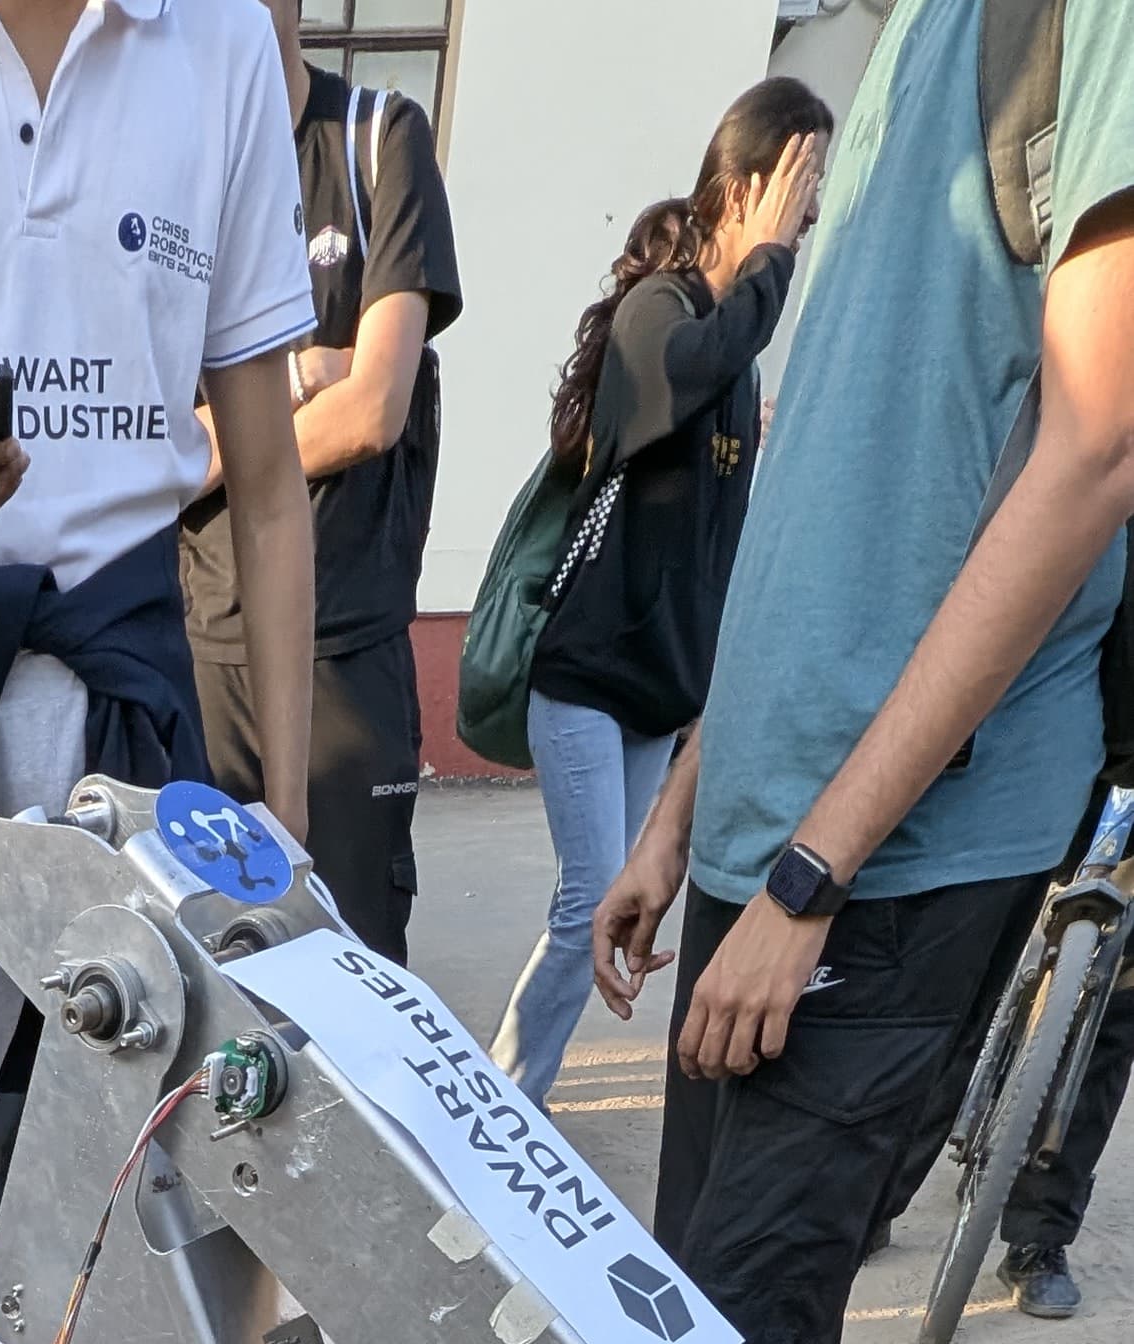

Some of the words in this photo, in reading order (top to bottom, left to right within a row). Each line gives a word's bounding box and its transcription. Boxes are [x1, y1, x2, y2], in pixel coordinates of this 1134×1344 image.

[149, 233, 213, 271] ROBOTICS
[2, 356, 113, 393] WART
[17, 404, 170, 440] DUSTRIE
[332, 950, 617, 1231] INDUSTRIES
[403, 1056, 588, 1249] DWART
